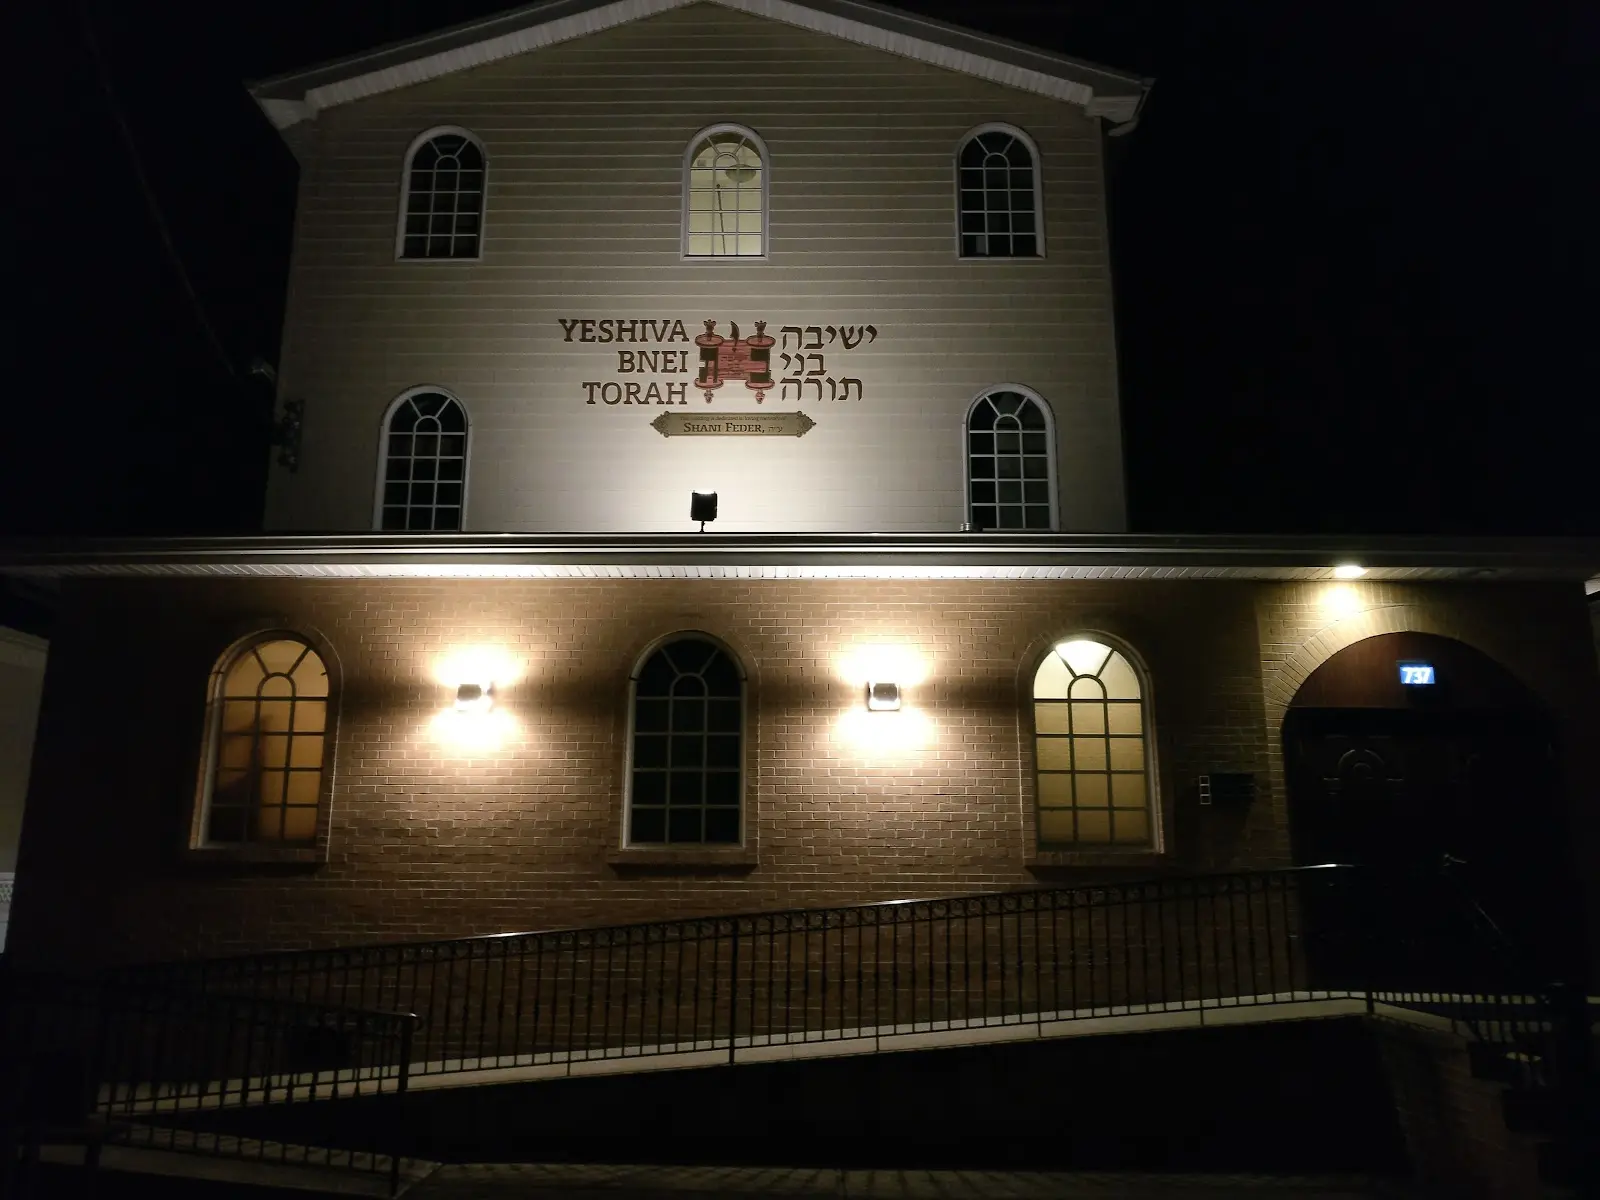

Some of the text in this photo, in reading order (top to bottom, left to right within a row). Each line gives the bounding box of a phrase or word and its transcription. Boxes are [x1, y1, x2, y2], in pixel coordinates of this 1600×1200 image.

[558, 319, 690, 343] YESHIVA
[780, 324, 878, 350] ישיבה
[617, 350, 689, 373] BNEI
[779, 352, 828, 376] בני
[582, 381, 688, 405] TORAH
[780, 377, 863, 401] תורה
[683, 422, 765, 434] SHANI FEDER,
[1401, 666, 1432, 684] 737
